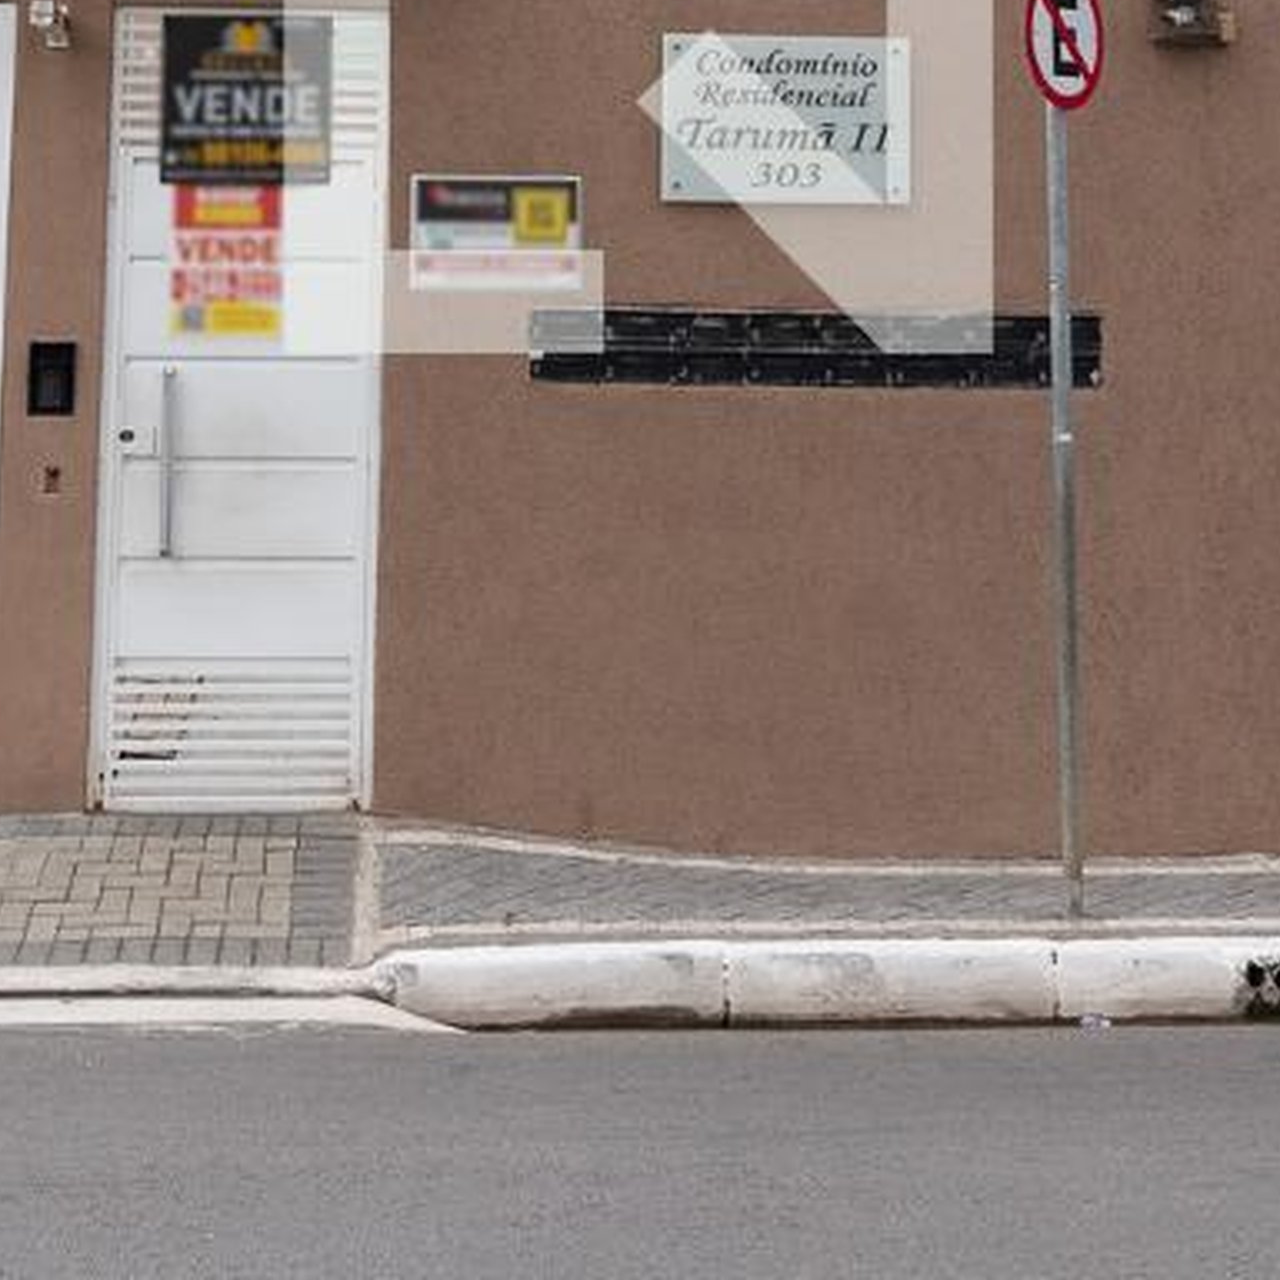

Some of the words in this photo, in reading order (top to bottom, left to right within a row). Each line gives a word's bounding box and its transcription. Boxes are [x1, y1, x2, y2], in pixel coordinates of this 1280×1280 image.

[173, 84, 320, 124] VENDE
[694, 80, 877, 108] Residencial
[676, 118, 837, 151] Tarumã
[852, 123, 889, 153] II
[750, 163, 822, 188] 303
[177, 238, 279, 264] VENDE
